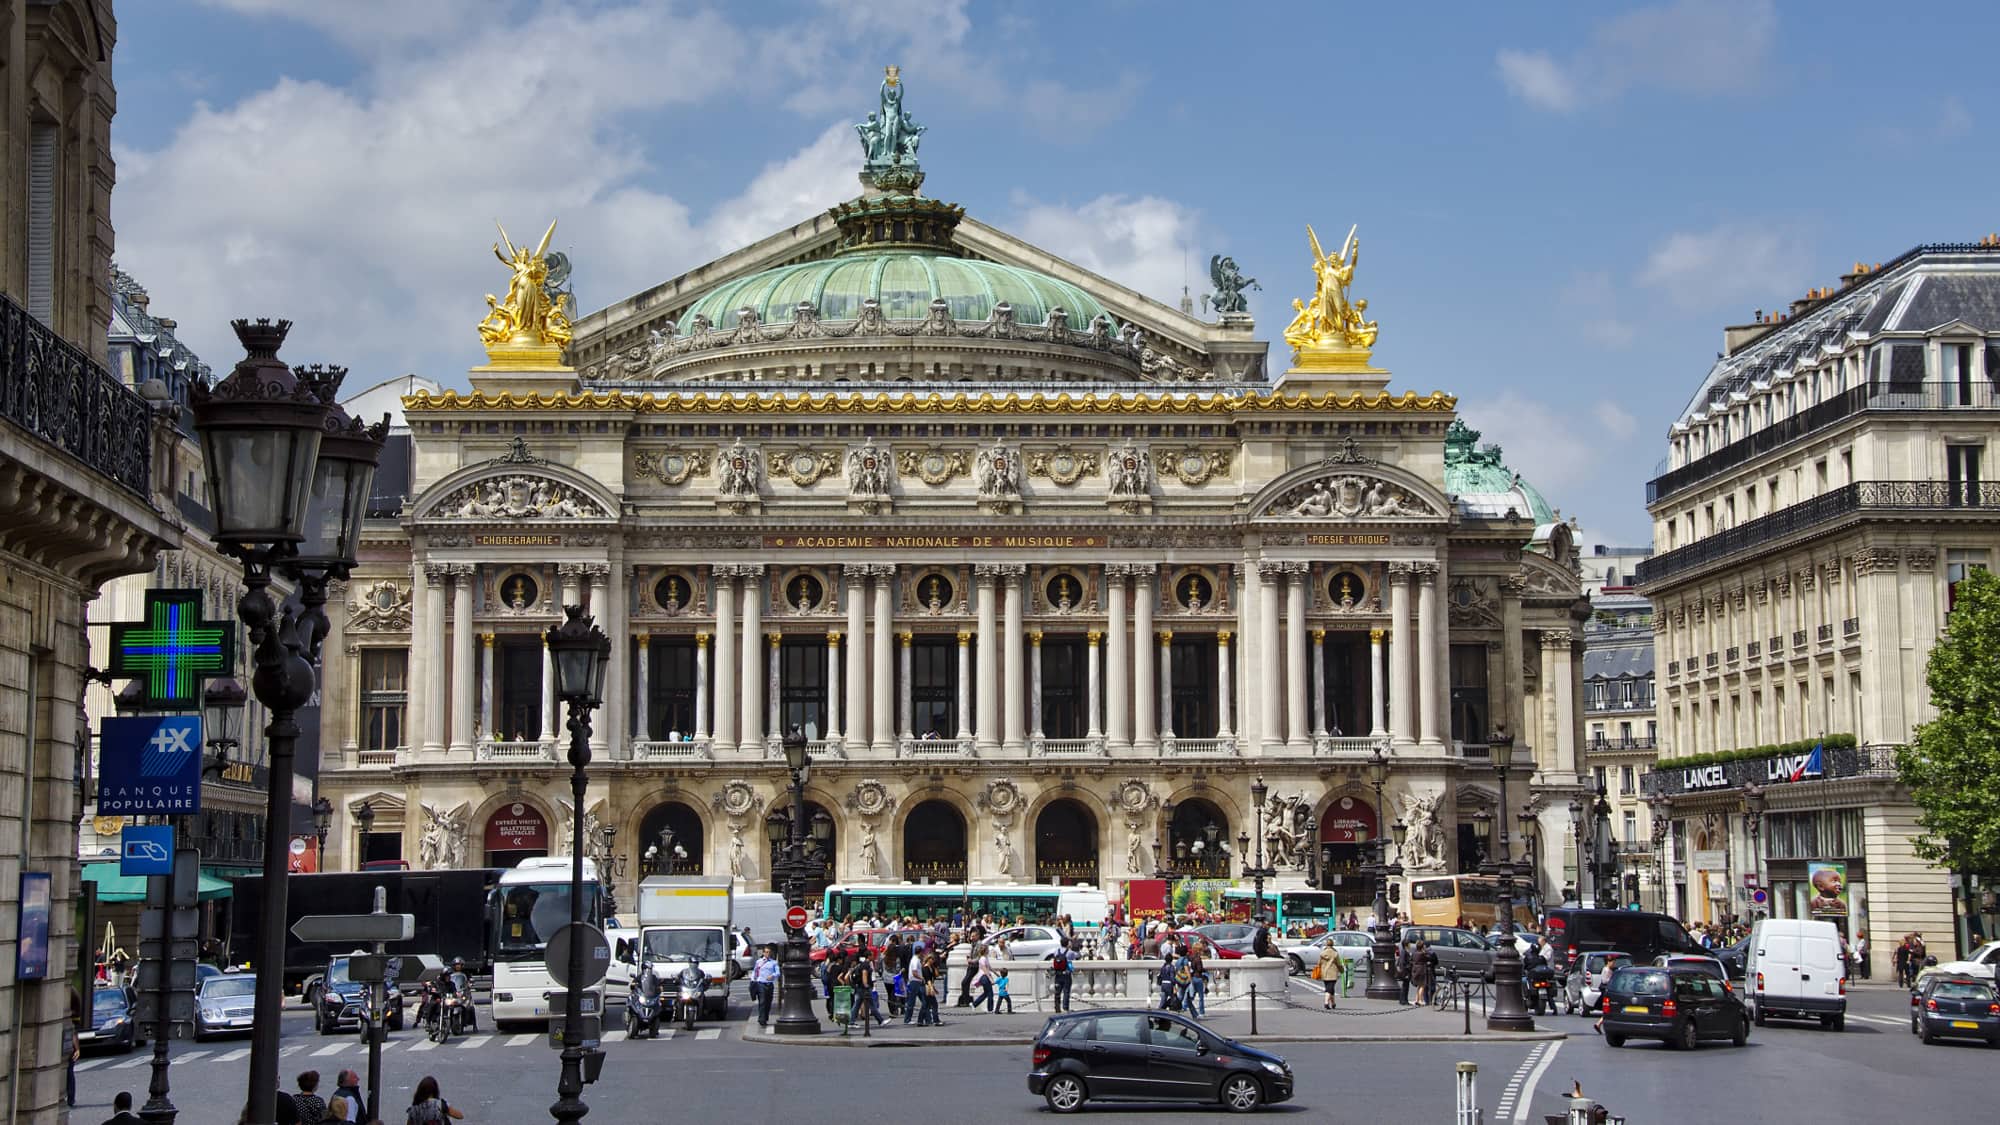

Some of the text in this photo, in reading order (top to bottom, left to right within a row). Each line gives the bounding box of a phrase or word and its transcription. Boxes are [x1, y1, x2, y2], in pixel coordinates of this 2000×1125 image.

[482, 535, 553, 545] CHOREGRAPHIE
[796, 537, 1074, 547] ACADEMIE NATIONALE DE MUSIQUE
[1312, 535, 1385, 545] POESIE LYRIQUE
[1683, 765, 1728, 789] LANCEL
[103, 785, 193, 797] BANQUE
[103, 799, 193, 810] POPULAIRE
